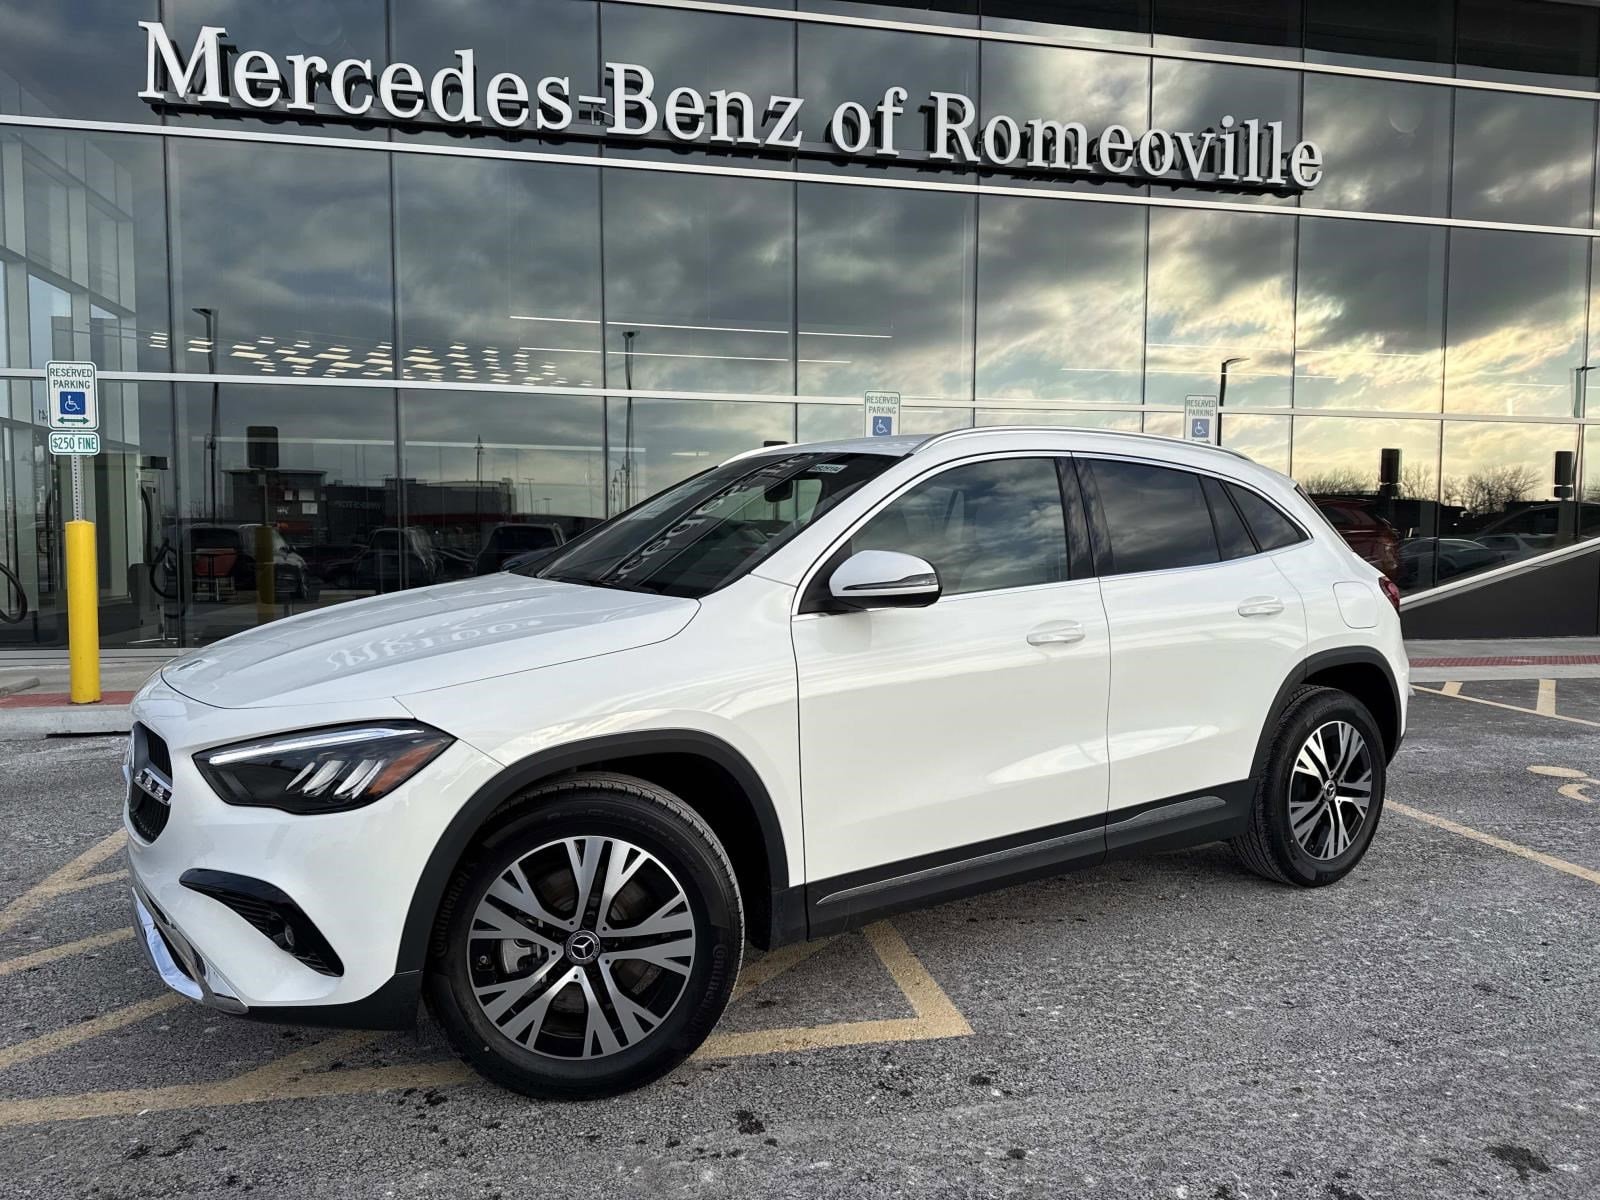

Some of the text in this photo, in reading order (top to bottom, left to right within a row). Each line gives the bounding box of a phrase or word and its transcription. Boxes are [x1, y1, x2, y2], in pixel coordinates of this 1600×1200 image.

[137, 20, 1324, 187] Mercedes-Benz of Romeoville
[50, 368, 92, 378] RESERVED
[53, 380, 91, 389] PARKING
[867, 396, 899, 405] RESERVED
[1187, 399, 1215, 408] RESERVED
[868, 406, 896, 415] PARKING
[1188, 409, 1214, 417] PARKING
[52, 437, 96, 450] $250 FINE
